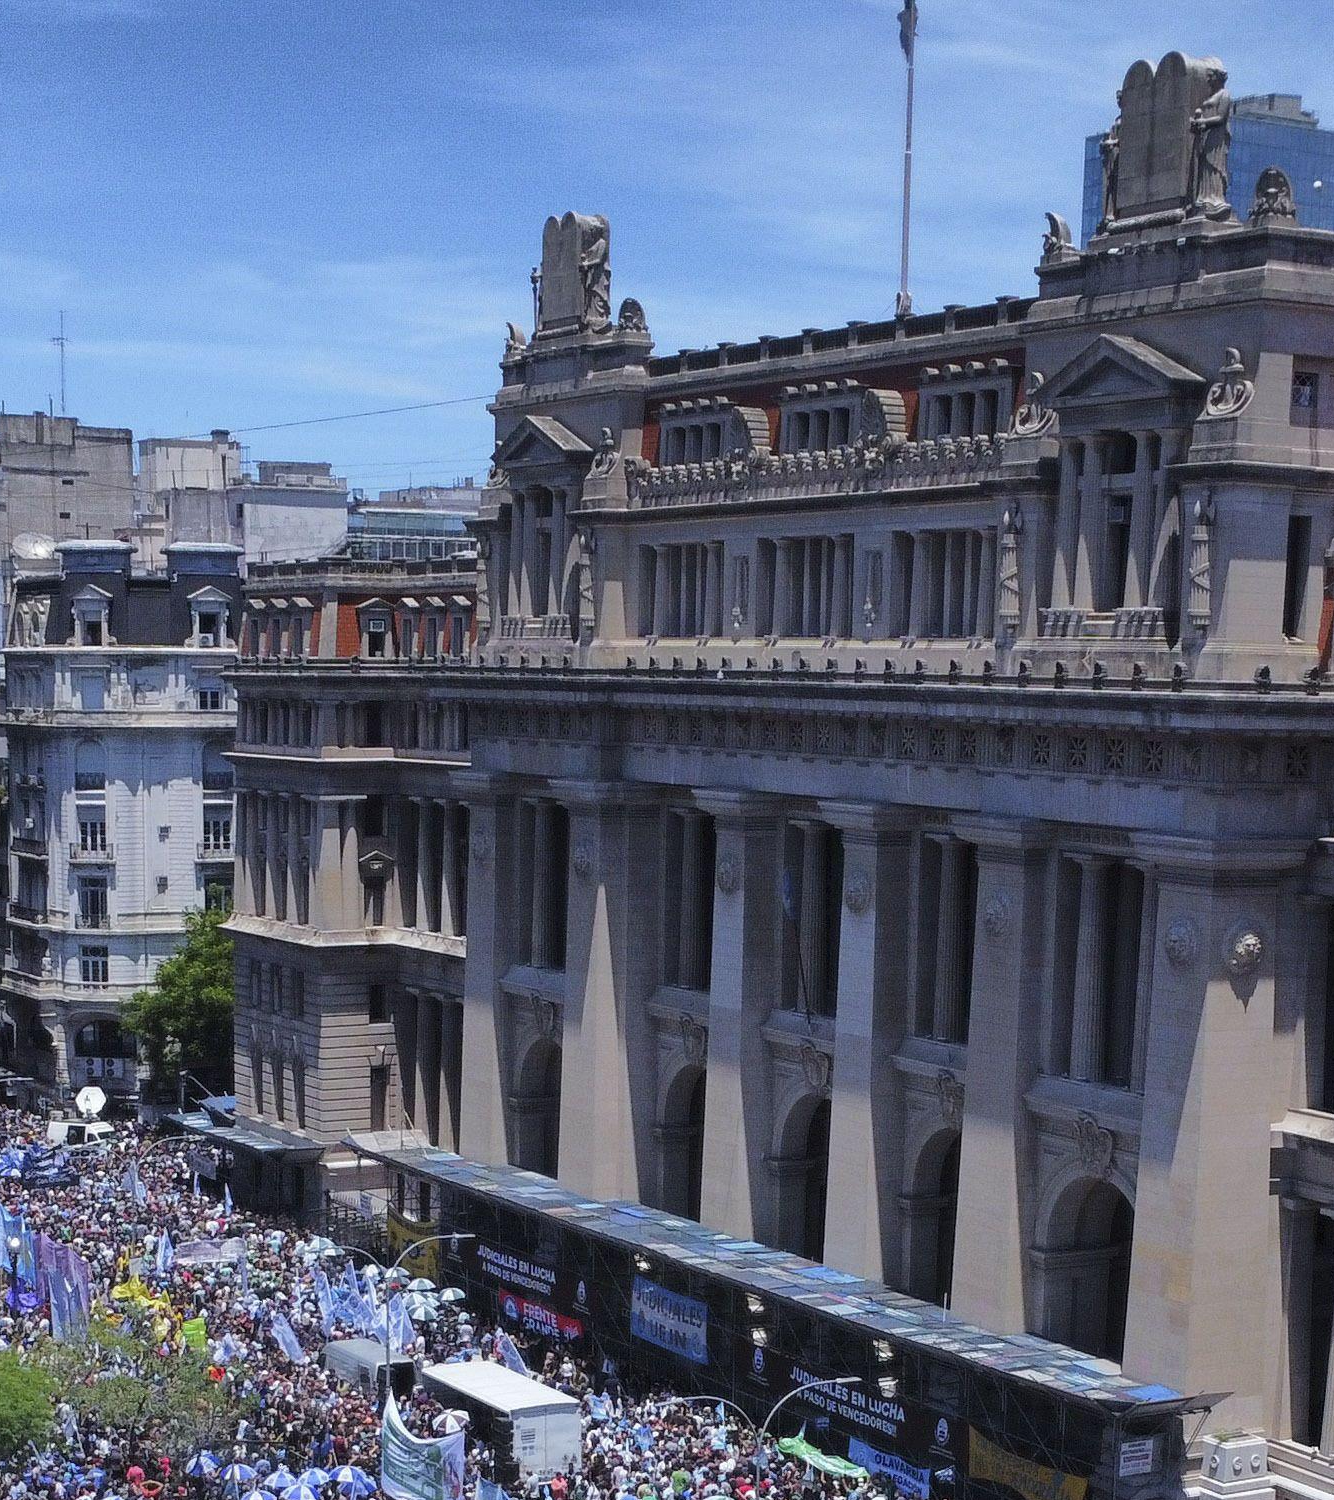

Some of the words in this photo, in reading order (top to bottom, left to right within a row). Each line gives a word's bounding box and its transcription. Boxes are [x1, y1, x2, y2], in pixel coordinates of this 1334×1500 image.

[478, 1245, 518, 1271] JUDICIALES
[519, 1260, 530, 1275] EN
[531, 1264, 557, 1285] LUCHA
[522, 1303, 558, 1324] FRENTE
[790, 1366, 849, 1402] JUDICIALES
[851, 1390, 866, 1408] EN
[869, 1398, 906, 1422] LUCHA
[804, 1393, 825, 1408] PASO
[827, 1400, 837, 1413] DE
